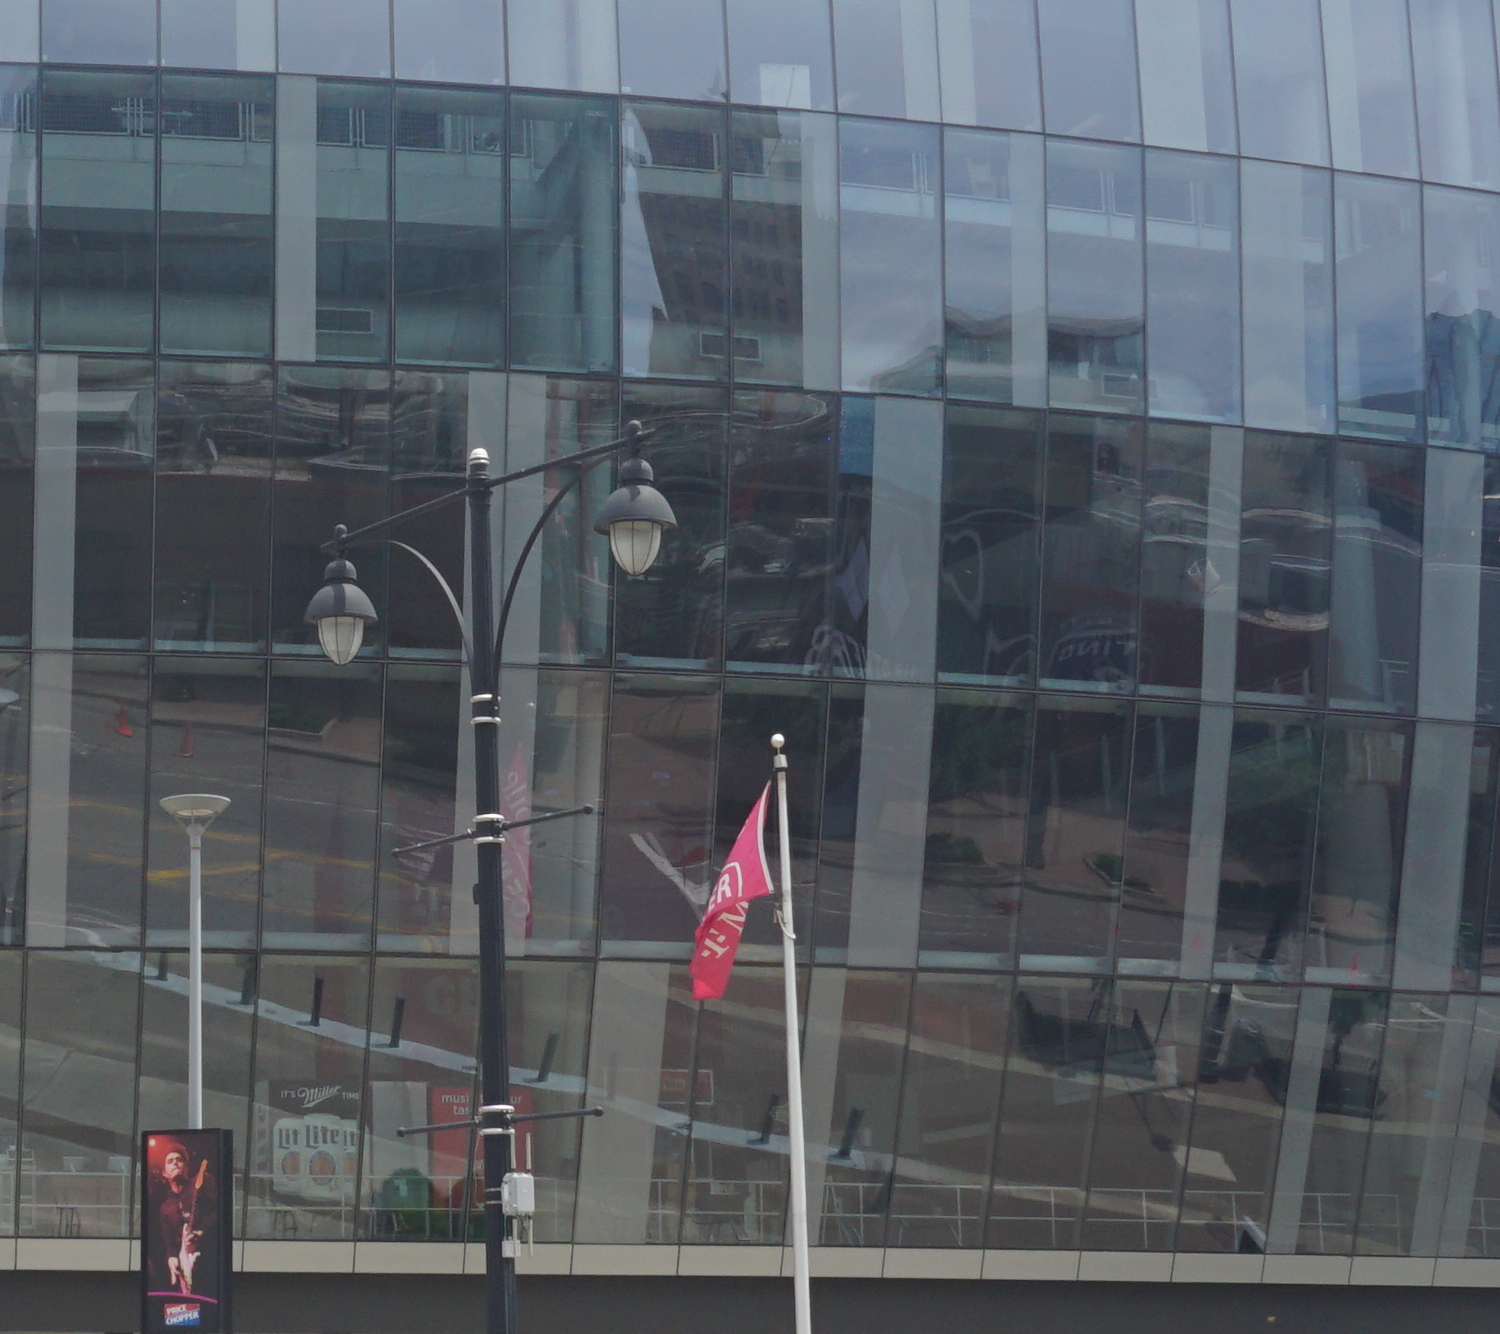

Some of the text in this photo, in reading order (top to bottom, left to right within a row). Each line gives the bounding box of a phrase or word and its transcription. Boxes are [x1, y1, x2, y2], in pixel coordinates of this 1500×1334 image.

[297, 1085, 342, 1108] Miller
[441, 1093, 470, 1103] musi
[278, 1128, 300, 1150] Lit
[304, 1124, 340, 1150] Lite
[165, 1310, 200, 1326] CHOPPER
[166, 1304, 187, 1316] PRICE
